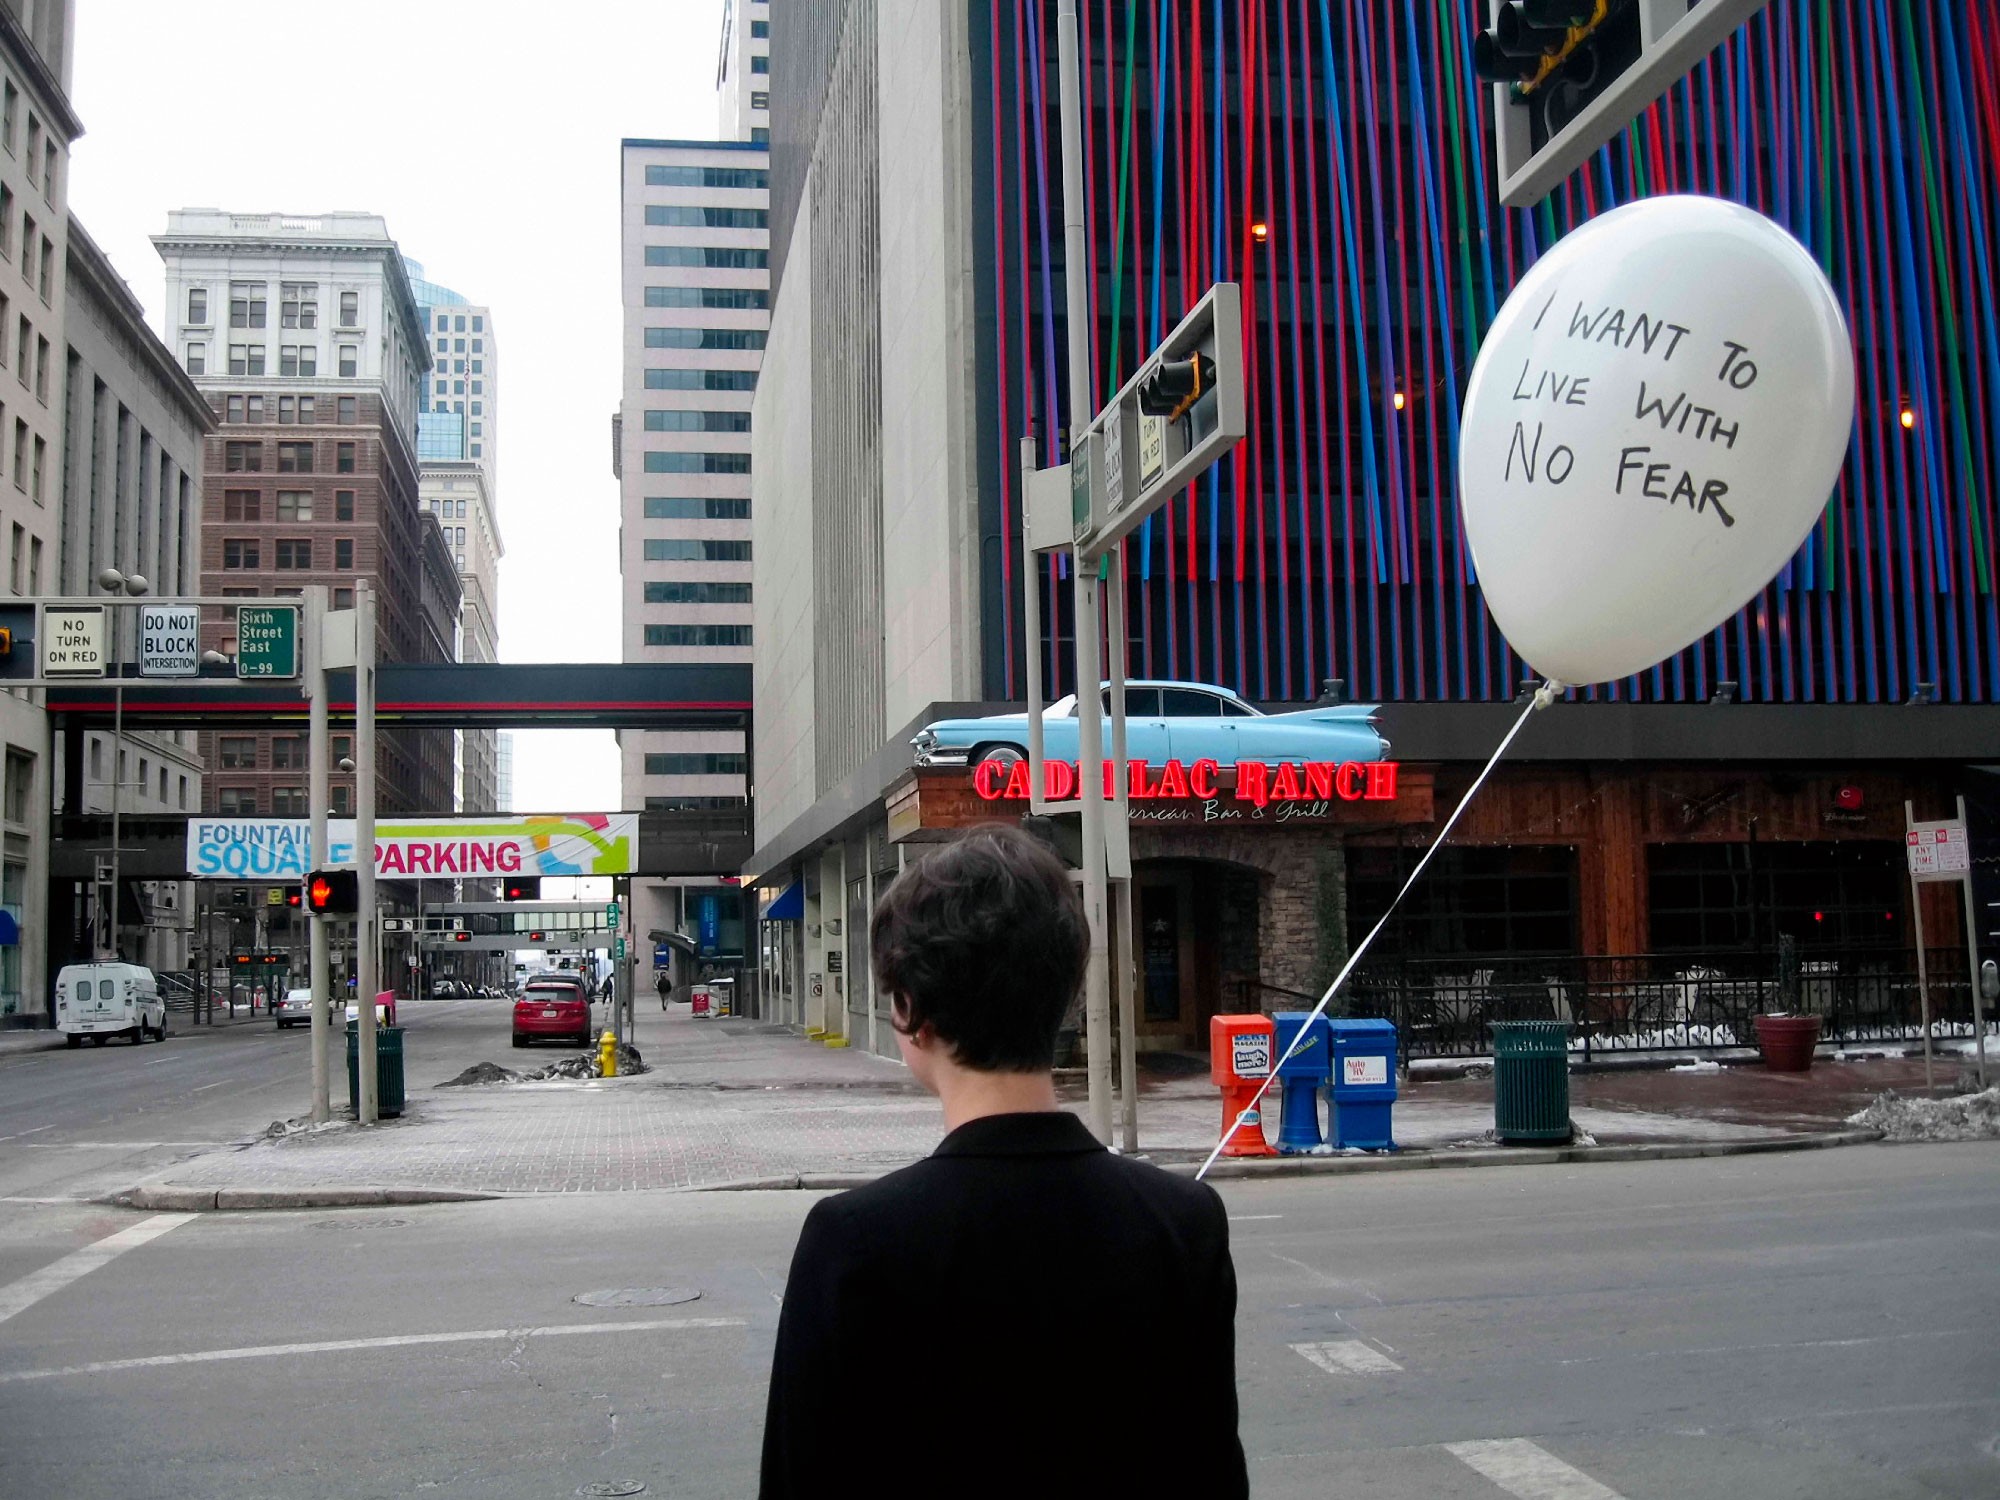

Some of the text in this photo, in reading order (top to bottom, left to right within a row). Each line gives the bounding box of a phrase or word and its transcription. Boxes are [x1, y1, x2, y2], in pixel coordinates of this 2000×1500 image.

[1533, 289, 1757, 389] I WANT TO
[1513, 358, 1739, 449] LIVE WITH
[1505, 421, 1735, 527] NO FEAR
[145, 614, 196, 630] DO NOT
[241, 611, 273, 624] Sixth
[63, 620, 85, 631] NO
[241, 625, 282, 638] Street
[57, 636, 91, 646] TURN
[145, 637, 195, 653] BLOCK
[241, 640, 270, 652] East
[50, 651, 97, 662] ON RED
[144, 657, 196, 668] INTERSECTION
[1235, 761, 1398, 807] RANCH
[1127, 800, 1329, 823] erican Bar & Grill
[1916, 846, 1930, 855] ANY
[197, 843, 353, 879] SQUAE
[1916, 856, 1933, 864] TIME
[1346, 1060, 1366, 1068] Auto
